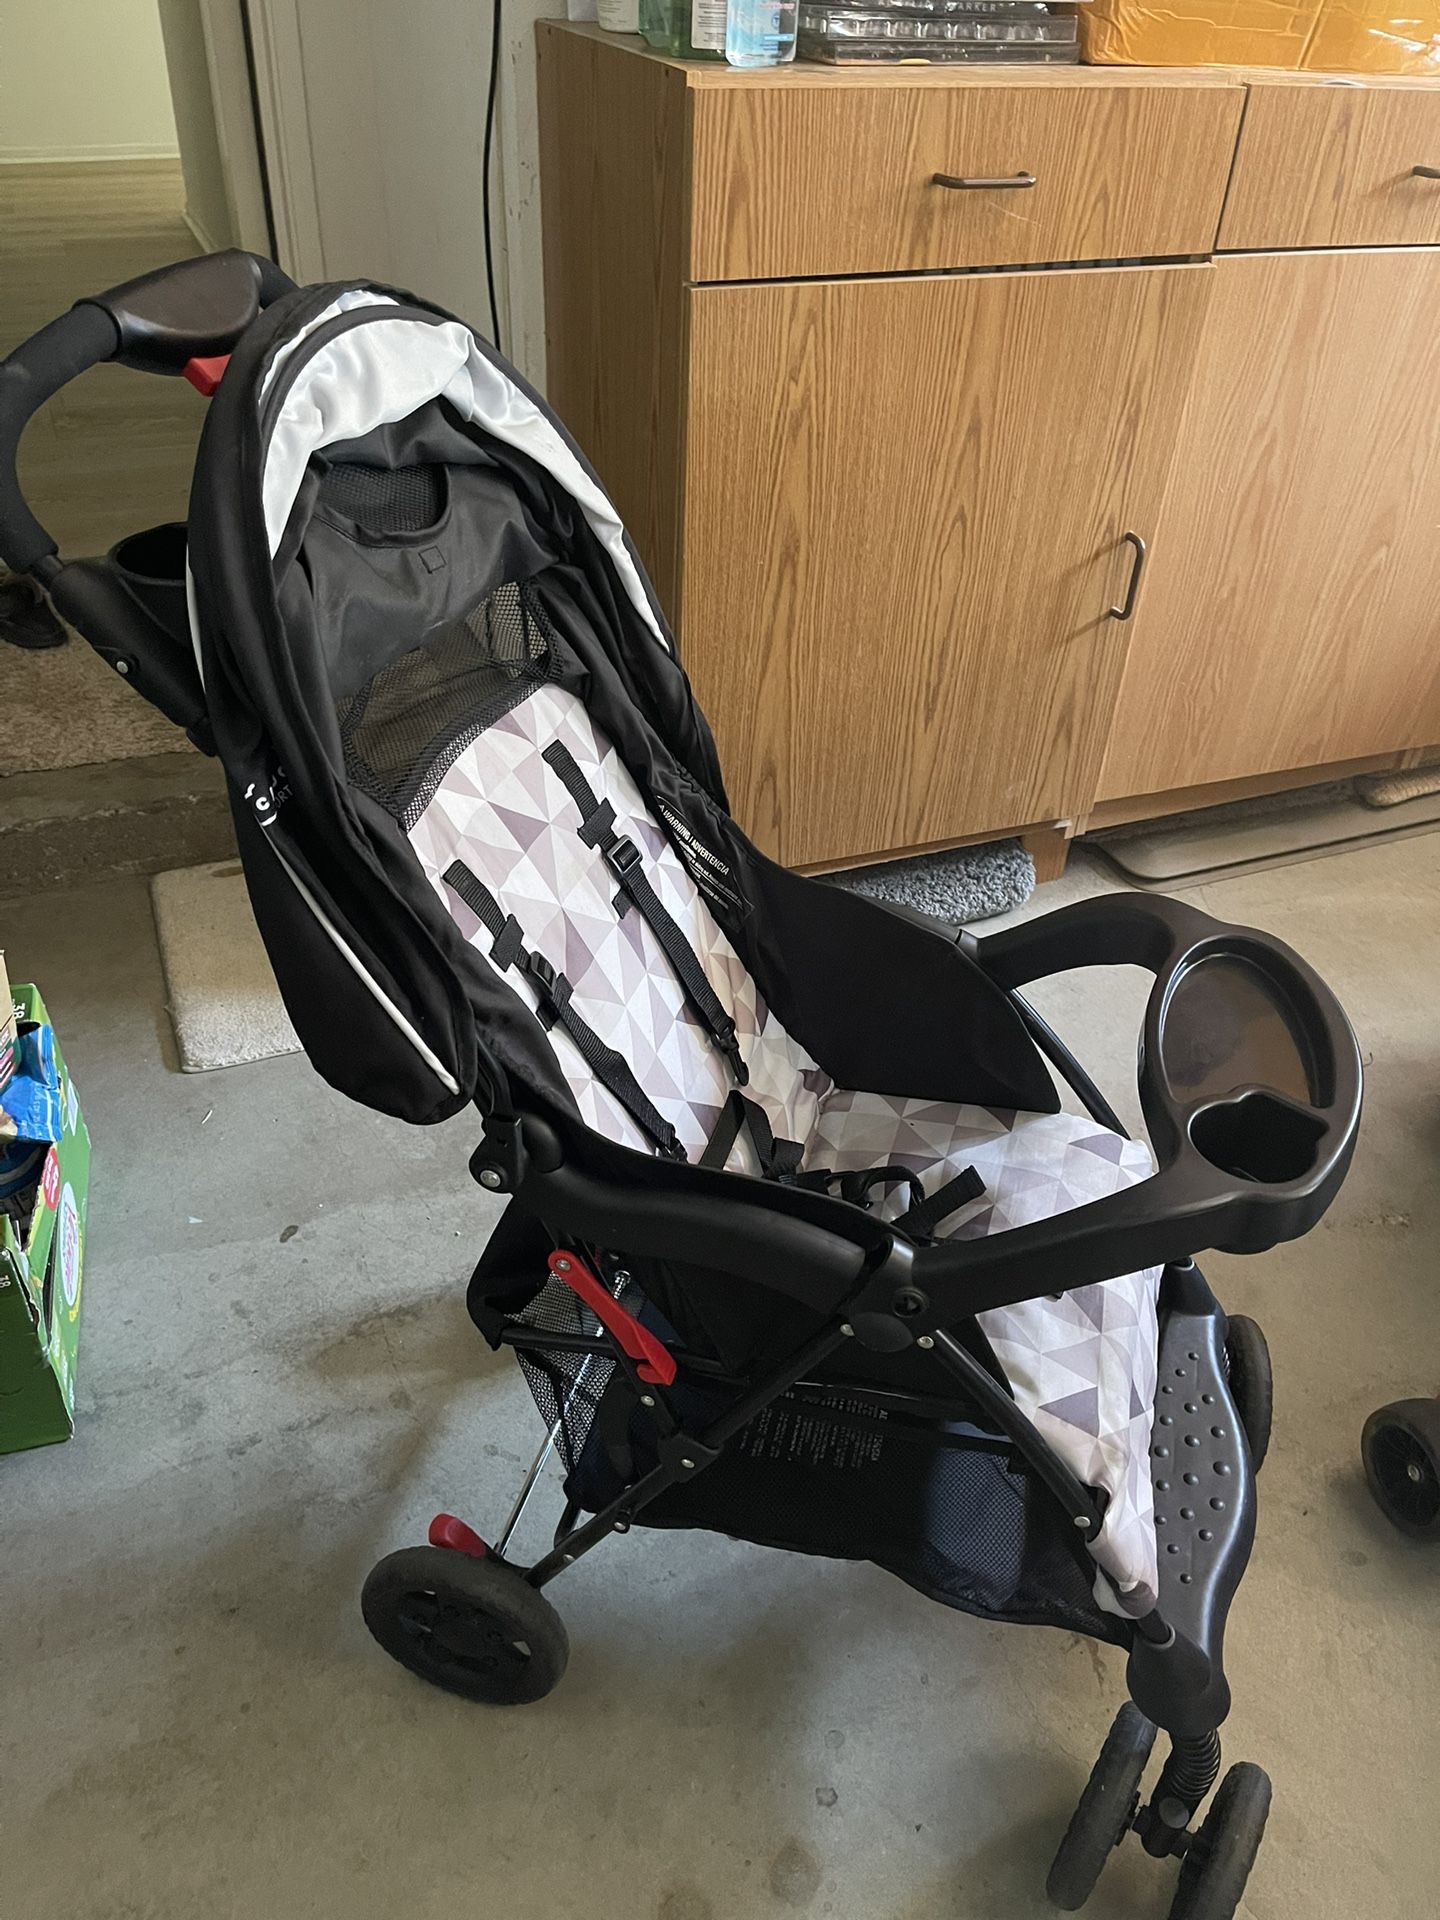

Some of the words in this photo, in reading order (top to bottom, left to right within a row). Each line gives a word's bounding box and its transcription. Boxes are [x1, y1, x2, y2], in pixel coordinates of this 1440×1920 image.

[945, 1, 997, 12] ARKER
[663, 810, 691, 840] WARNING
[691, 839, 730, 876] ADVERTENCIA
